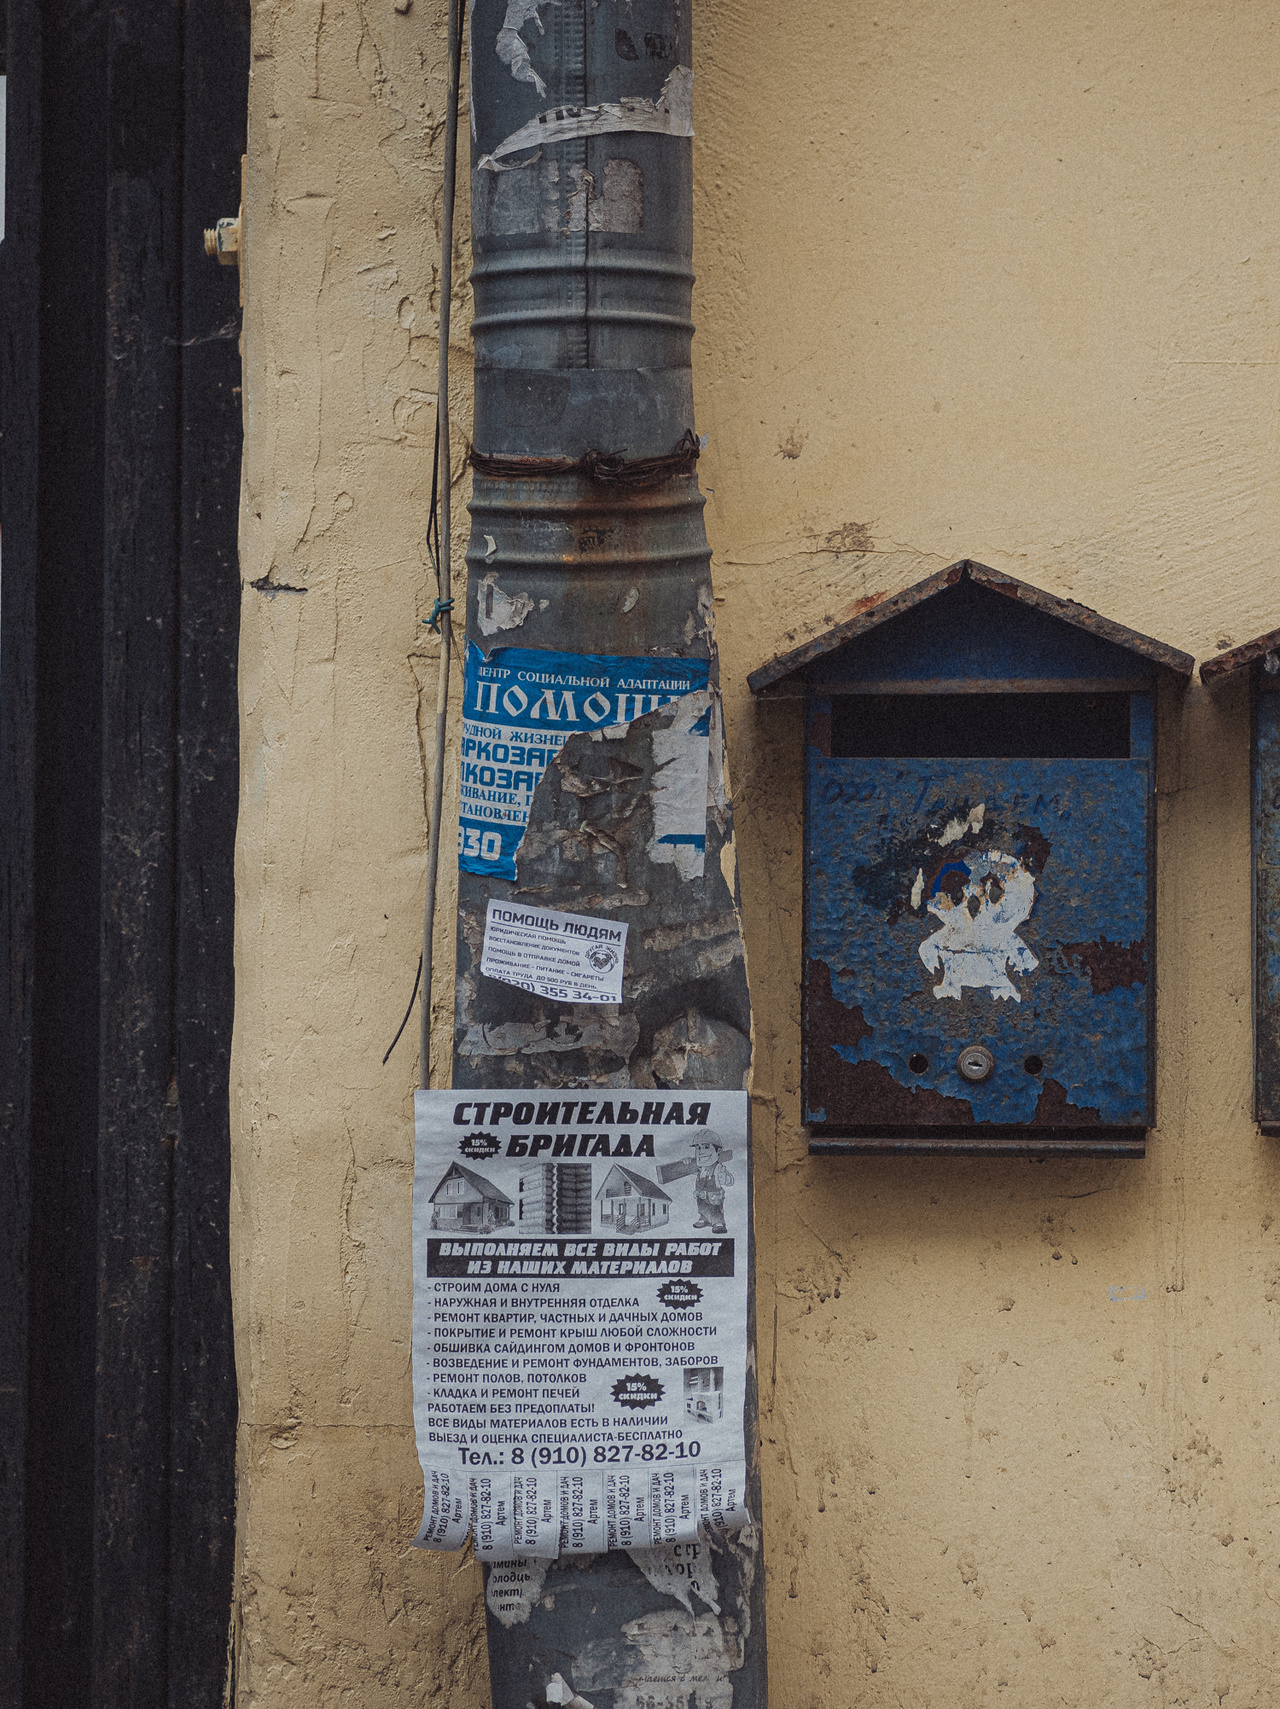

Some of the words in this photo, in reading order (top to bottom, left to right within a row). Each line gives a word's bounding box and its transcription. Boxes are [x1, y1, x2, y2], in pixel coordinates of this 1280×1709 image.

[517, 671, 610, 688] СОЦИАЛЬНОЙ
[617, 678, 690, 690] АДАПТАЦИИ
[473, 680, 681, 723] ПОМОЩ
[510, 731, 566, 746] ЖИЗНЕ
[461, 761, 543, 791] КОЗА
[490, 926, 536, 939] ЮРИДИЧЕСКАЯ
[538, 935, 567, 944] ПОМОЩЬ
[492, 908, 559, 931] ПОМОЩЬ
[563, 922, 622, 942] ЛЮДЯМ
[540, 985, 568, 998] 355
[453, 1101, 711, 1125] СТРОИТЕЛЬНАЯ
[471, 1139, 488, 1147] 15%
[505, 1134, 656, 1157] БРИГАДА
[439, 1242, 559, 1257] ВЫПОЛНЯЕМ
[564, 1242, 598, 1257] ВСЕ
[602, 1242, 660, 1257] ВИДЫ
[665, 1242, 722, 1256] РАБОТ
[467, 1260, 492, 1274] ИЗ
[497, 1260, 566, 1275] НАШИХ
[570, 1260, 693, 1275] МАТЕРИАЛОВ
[434, 1282, 481, 1293] СТРОИМ
[484, 1283, 518, 1294] ДОМА
[521, 1283, 529, 1293] С
[531, 1283, 560, 1293] НУЛЯ
[670, 1285, 689, 1293] 15%
[434, 1297, 497, 1308] НАРУЖНАЯ
[500, 1298, 508, 1308] И
[511, 1298, 586, 1308] ВНУТРЕННЯЯ
[590, 1297, 639, 1309] ОТДЕЛКА
[434, 1312, 480, 1322] РЕМОНТ
[484, 1313, 536, 1325] КВАРТИР,
[540, 1313, 595, 1323] ЧАСТНЫХ
[599, 1313, 606, 1323] И
[609, 1312, 658, 1324] ДАЧНЫХ
[661, 1312, 703, 1323] ДОМОВ
[434, 1327, 495, 1338] ПОКРЫТИЕ
[499, 1328, 506, 1338] И
[510, 1328, 557, 1338] РЕМОНТ
[560, 1328, 597, 1338] КРЫШ
[600, 1325, 643, 1337] ЛЮБОЙ
[646, 1326, 717, 1337] СЛОЖНОСТИ
[433, 1343, 491, 1353] ОБШИВКА
[494, 1341, 565, 1354] САЙДИНГОМ
[568, 1343, 610, 1354] ДОМОВ
[613, 1343, 621, 1352] И
[625, 1342, 695, 1352] ФРОНТОНОВ
[433, 1358, 508, 1369] ВОЗВЕДЕНИЕ
[511, 1359, 519, 1368] И
[523, 1359, 570, 1368] РЕМОНТ
[573, 1357, 662, 1369] ФУНДАМЕНТОВ,
[665, 1356, 719, 1366] ЗАБОРОВ
[433, 1373, 479, 1383] РЕМОНТ
[482, 1374, 524, 1384] ПОЛОВ,
[527, 1373, 587, 1383] ПОТОЛКОВ
[625, 1382, 647, 1392] 15%
[433, 1388, 477, 1399] КЛАДКА
[480, 1389, 488, 1398] И
[492, 1389, 539, 1398] РЕМОНТ
[542, 1386, 580, 1398] ПЕЧЕЙ
[428, 1403, 486, 1413] РАБОТАЕМ
[490, 1404, 512, 1413] БЕЗ
[515, 1403, 595, 1415] ПРЕДОПЛАТЫ!
[428, 1418, 449, 1428] ВСЕ
[452, 1419, 486, 1430] ВИДЫ
[490, 1419, 567, 1428] МАТЕРИАЛОВ
[570, 1418, 599, 1428] ЕСТЬ
[602, 1418, 610, 1427] В
[613, 1416, 668, 1426] НАЛИЧИИ
[429, 1432, 468, 1445] ВЫЕЗД
[470, 1434, 478, 1443] И
[481, 1434, 528, 1444] ОЦЕНКА
[458, 1447, 504, 1465] Тел.:
[511, 1447, 525, 1465] 8
[531, 1446, 588, 1468] (910)
[593, 1440, 701, 1463] 827-82-10
[440, 1473, 451, 1513] 827-82-10
[526, 1477, 537, 1515] 827-82-10
[572, 1476, 583, 1517] 827-82-10
[619, 1475, 630, 1515] 827-82-10
[663, 1472, 675, 1514] 827-82-10
[711, 1468, 722, 1508] 827-82-10
[481, 1478, 492, 1520] 827-82-10
[634, 1496, 646, 1522] Артем
[679, 1494, 691, 1520] Артем
[725, 1488, 737, 1512] Артем
[452, 1498, 462, 1523] Артем
[495, 1500, 507, 1526] Артем
[541, 1499, 554, 1523] Артем
[587, 1499, 600, 1524] Артем
[437, 1515, 451, 1536] (910)
[481, 1521, 494, 1543] (910)
[526, 1516, 539, 1537] (910)
[572, 1519, 585, 1540] (910)
[619, 1517, 633, 1538] (910)
[664, 1515, 677, 1536] (910)
